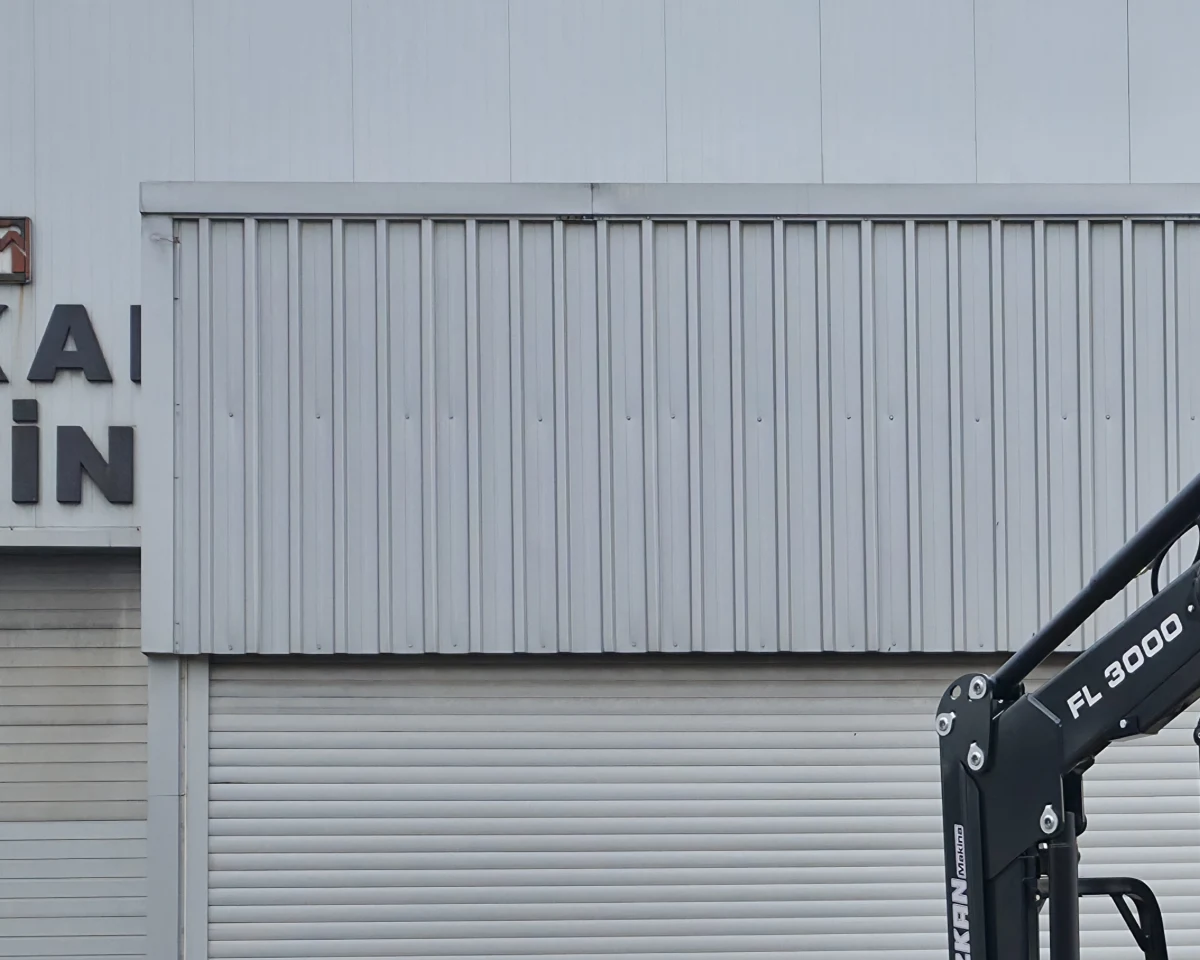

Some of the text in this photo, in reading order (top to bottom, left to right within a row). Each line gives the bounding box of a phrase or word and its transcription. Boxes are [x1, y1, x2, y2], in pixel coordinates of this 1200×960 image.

[1066, 613, 1183, 719] FL 3000
[956, 826, 966, 877] Makina
